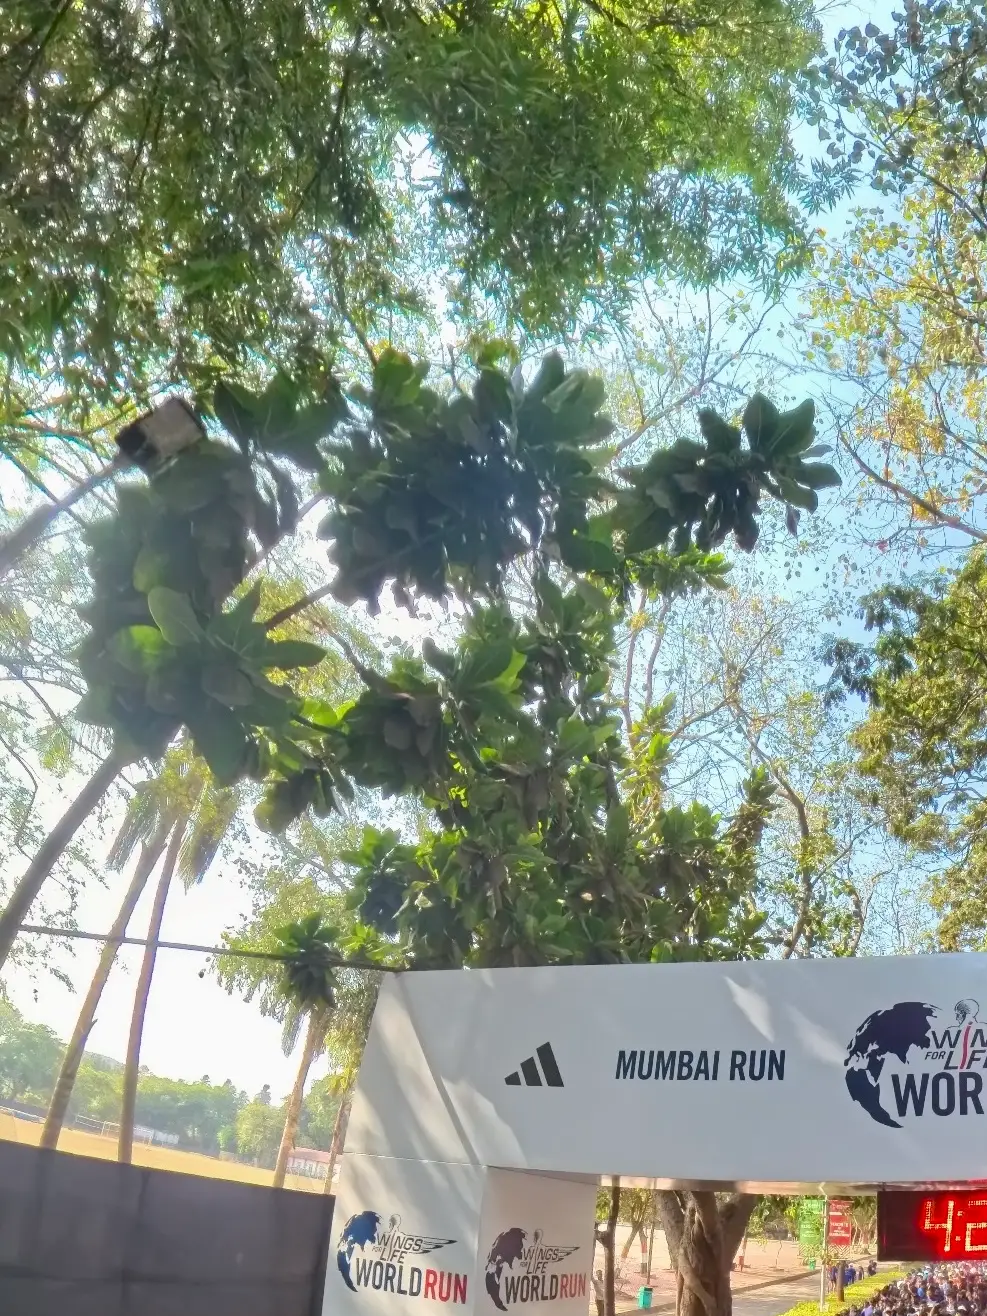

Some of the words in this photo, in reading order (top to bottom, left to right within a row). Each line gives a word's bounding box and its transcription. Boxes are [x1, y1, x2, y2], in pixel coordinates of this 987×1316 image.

[615, 1050, 720, 1081] MUMBAI
[729, 1049, 786, 1081] RUN
[924, 1050, 946, 1061] FOR
[377, 1231, 424, 1252] WINGS
[379, 1247, 406, 1264] LIFE
[521, 1247, 559, 1262] WINGS
[526, 1261, 548, 1276] LIFE
[355, 1257, 423, 1297] WORLD
[423, 1268, 468, 1305] RUN
[505, 1269, 559, 1305] WORLD
[560, 1272, 587, 1300] RUN
